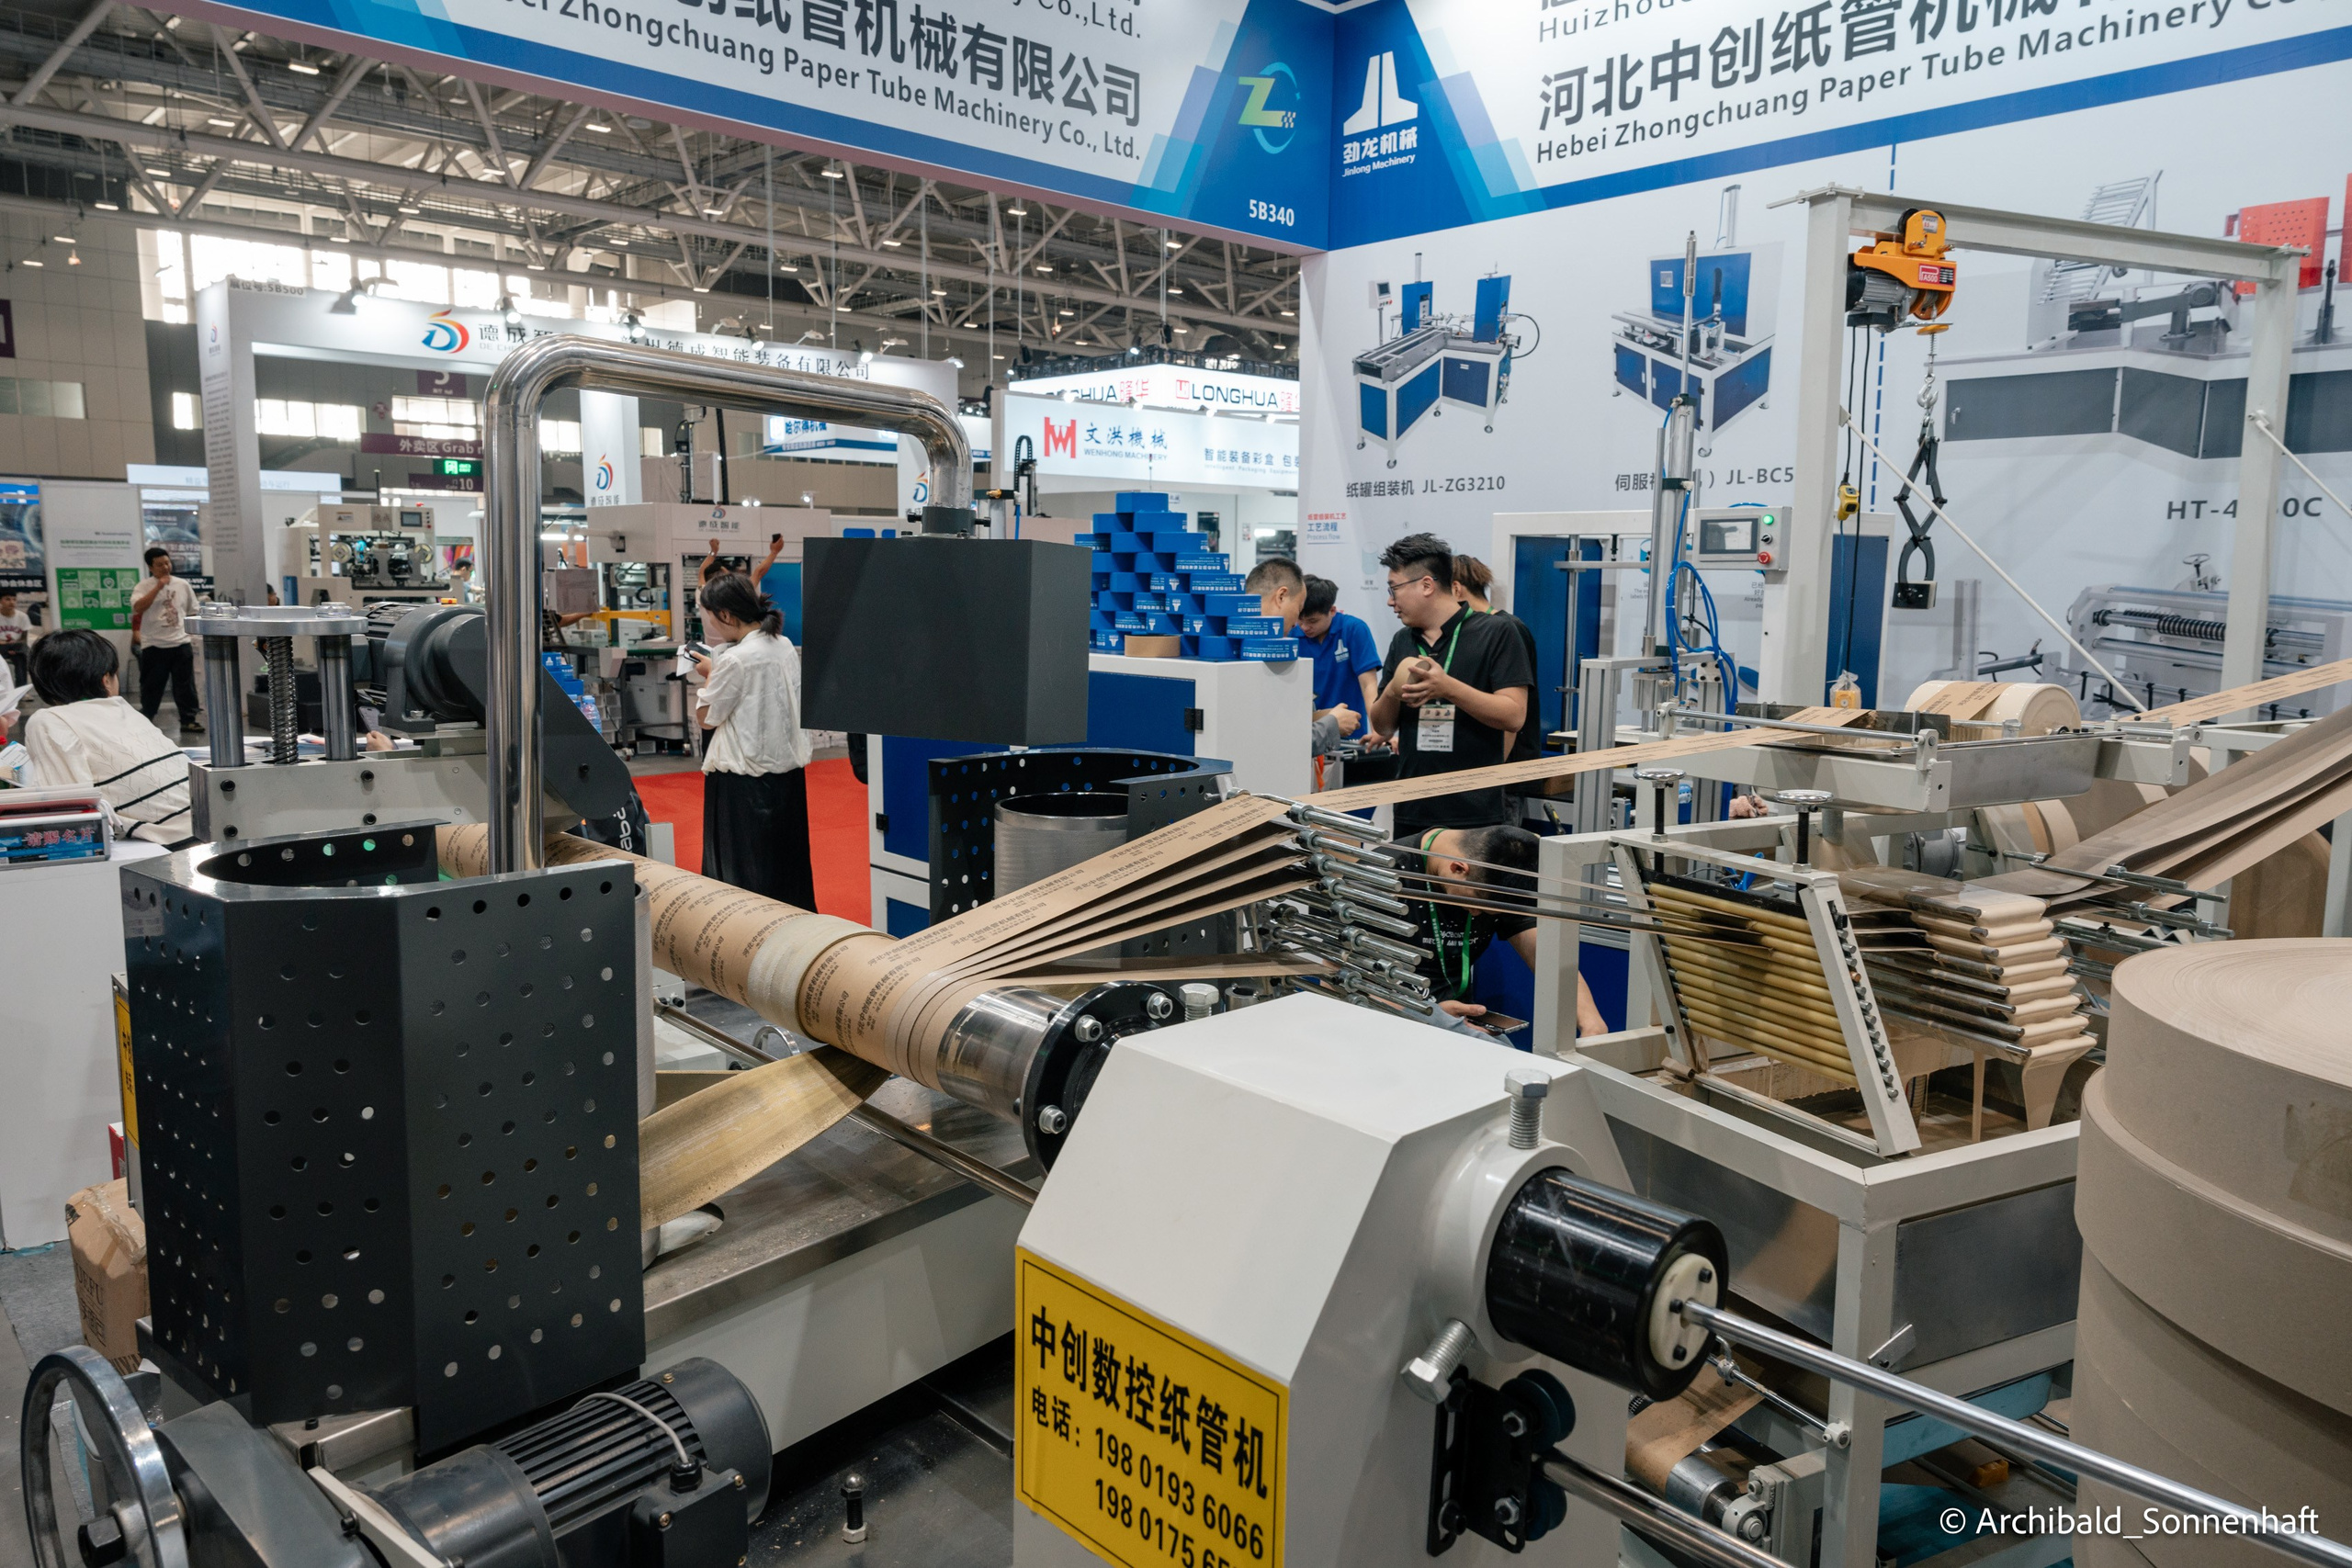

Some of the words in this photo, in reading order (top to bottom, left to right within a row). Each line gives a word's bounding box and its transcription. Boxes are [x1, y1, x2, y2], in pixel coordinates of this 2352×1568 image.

[559, 0, 775, 74] Zhongchuang
[785, 47, 859, 89] Paper
[872, 69, 927, 107] Tube
[934, 86, 1054, 144] Machinery
[1058, 120, 1098, 153] Co.,
[1104, 130, 1141, 161] Ltd.
[1537, 131, 1608, 164] Hebei
[1615, 83, 1809, 147] Zhongchuang
[1820, 63, 1912, 104] Paper
[1922, 39, 2005, 81] Tube
[2018, 0, 2232, 61] Machinery
[1343, 126, 1418, 164] 劲龙机械
[1342, 164, 1371, 177] Jinlong
[1372, 154, 1416, 171] Machinery
[1249, 198, 1295, 228] 5B340
[1193, 383, 1279, 409] LONGHUA
[400, 439, 440, 454] 外卖区
[442, 442, 474, 455] Grab
[1084, 448, 1124, 458] WENHONG
[459, 478, 474, 491] 10
[1346, 479, 1415, 499] 纸罐组装机
[1422, 476, 1506, 494] JL-ZG3210
[1306, 522, 1339, 533] 工艺流程
[1031, 1304, 1268, 1500] 中创数控纸管机
[1094, 1427, 1134, 1477] 198
[1139, 1454, 1195, 1517] 0193
[1202, 1494, 1264, 1561] 6066
[1094, 1478, 1134, 1529] 198
[1139, 1506, 1195, 1568] 0175
